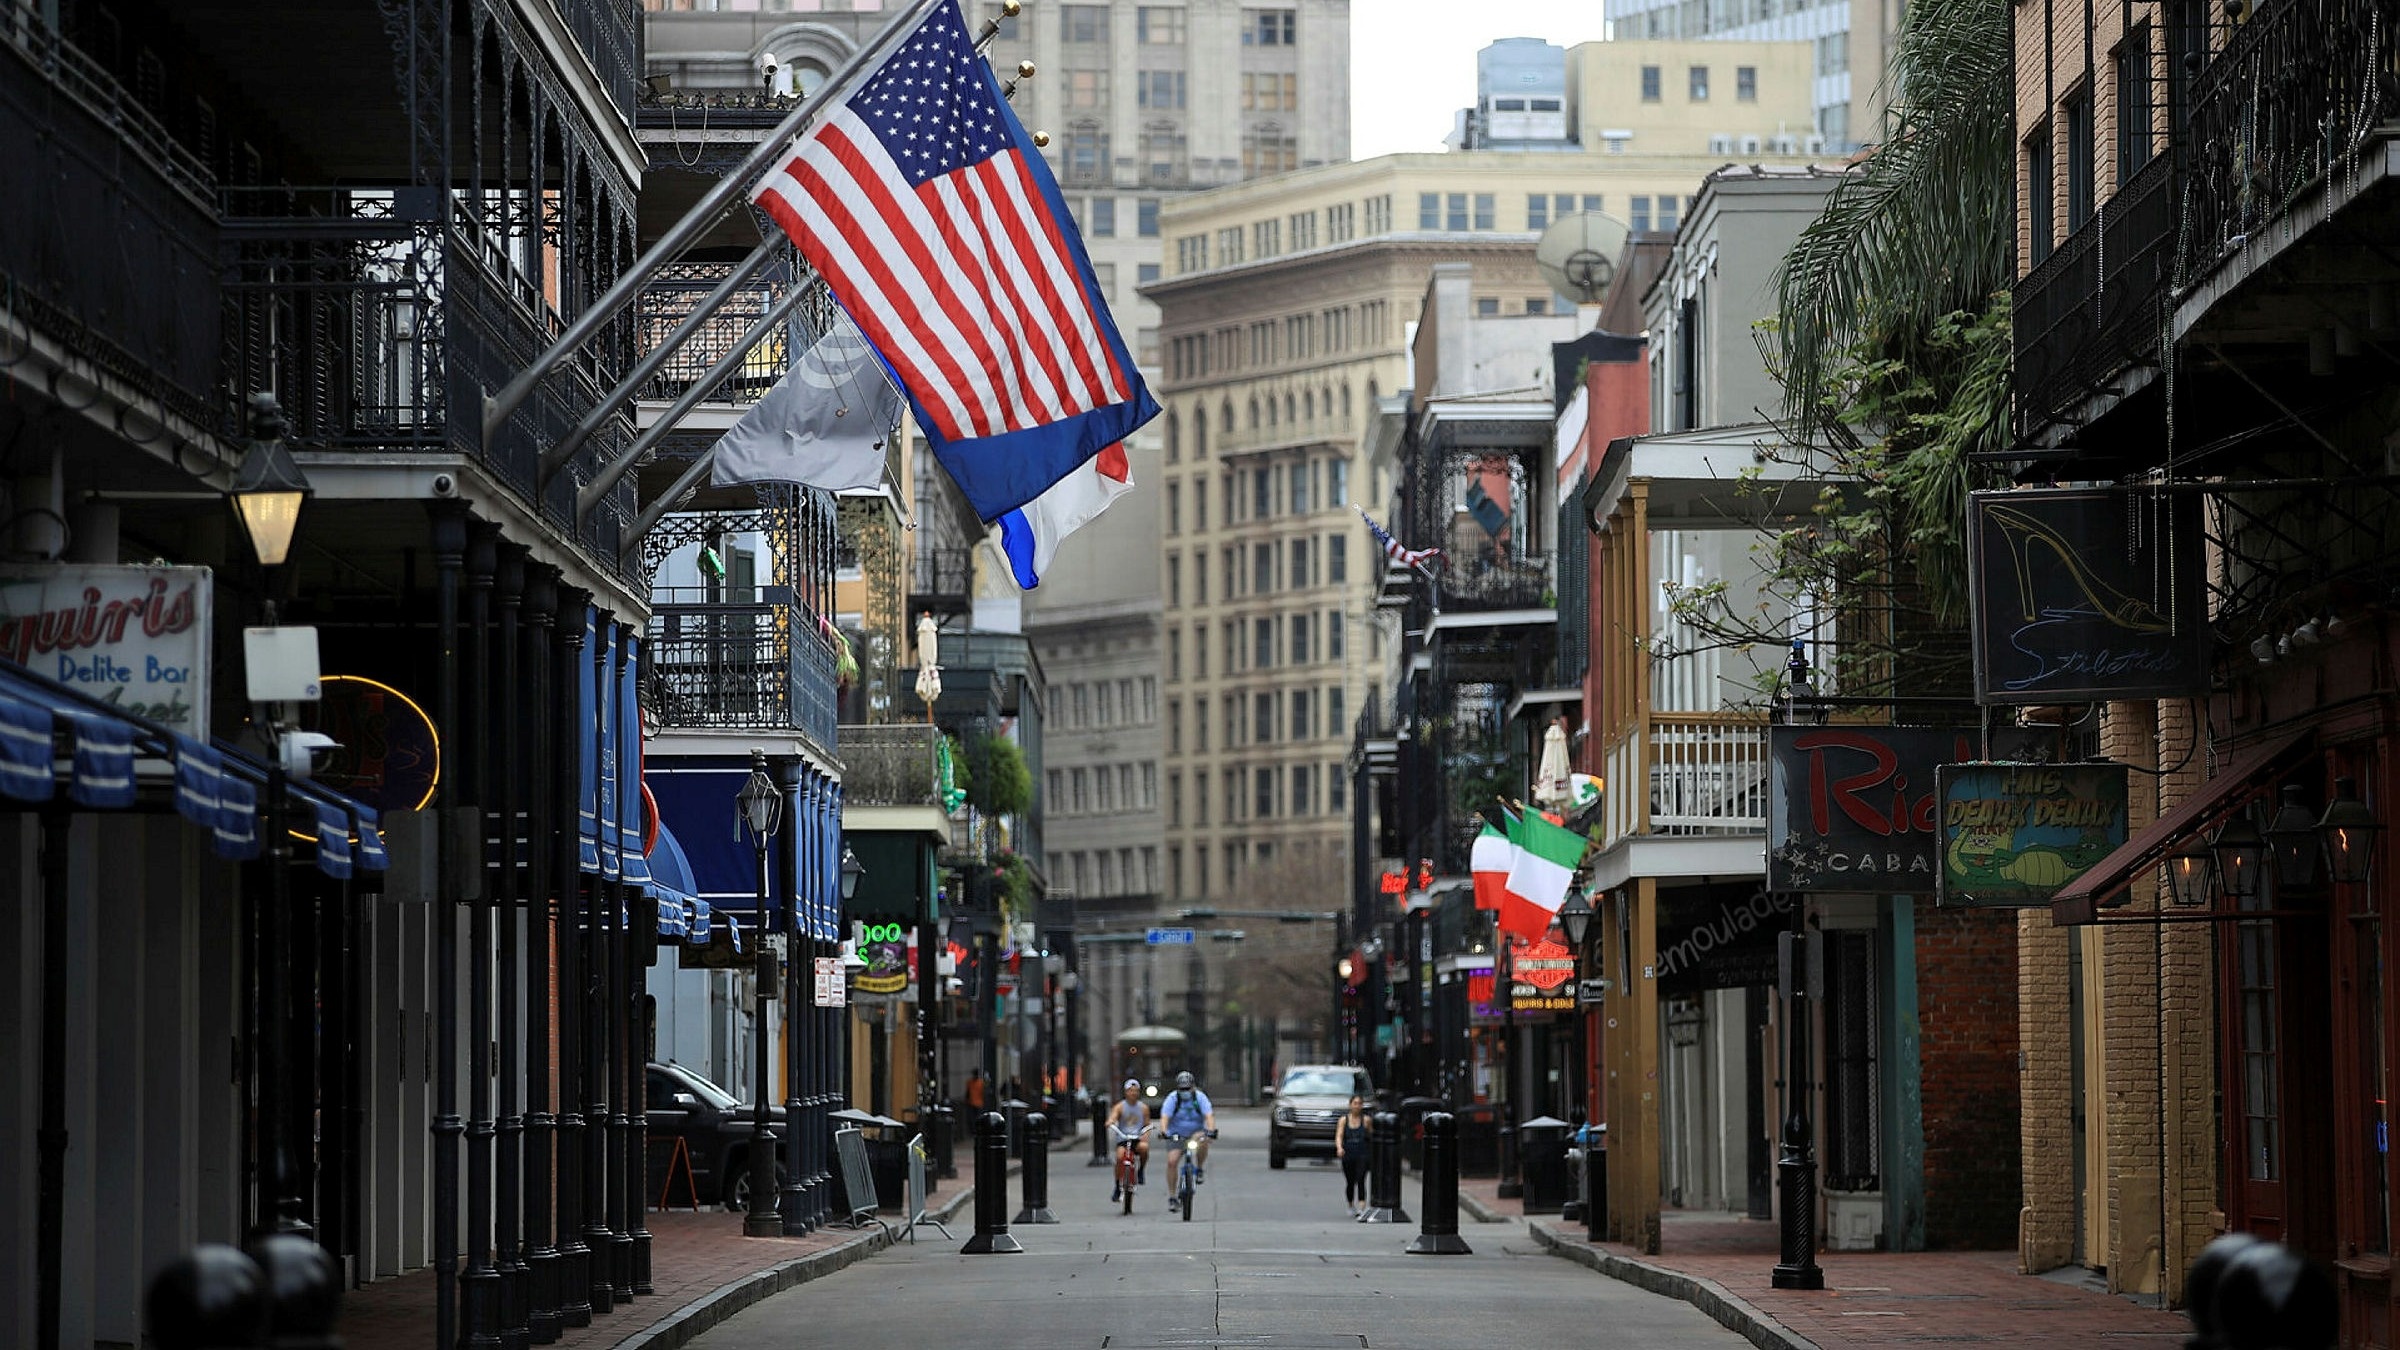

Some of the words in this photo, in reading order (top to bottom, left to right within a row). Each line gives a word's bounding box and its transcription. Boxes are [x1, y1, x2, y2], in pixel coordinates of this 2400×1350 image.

[58, 653, 132, 683] Delite
[146, 655, 189, 683] Bar
[2001, 769, 2063, 795] FAIS
